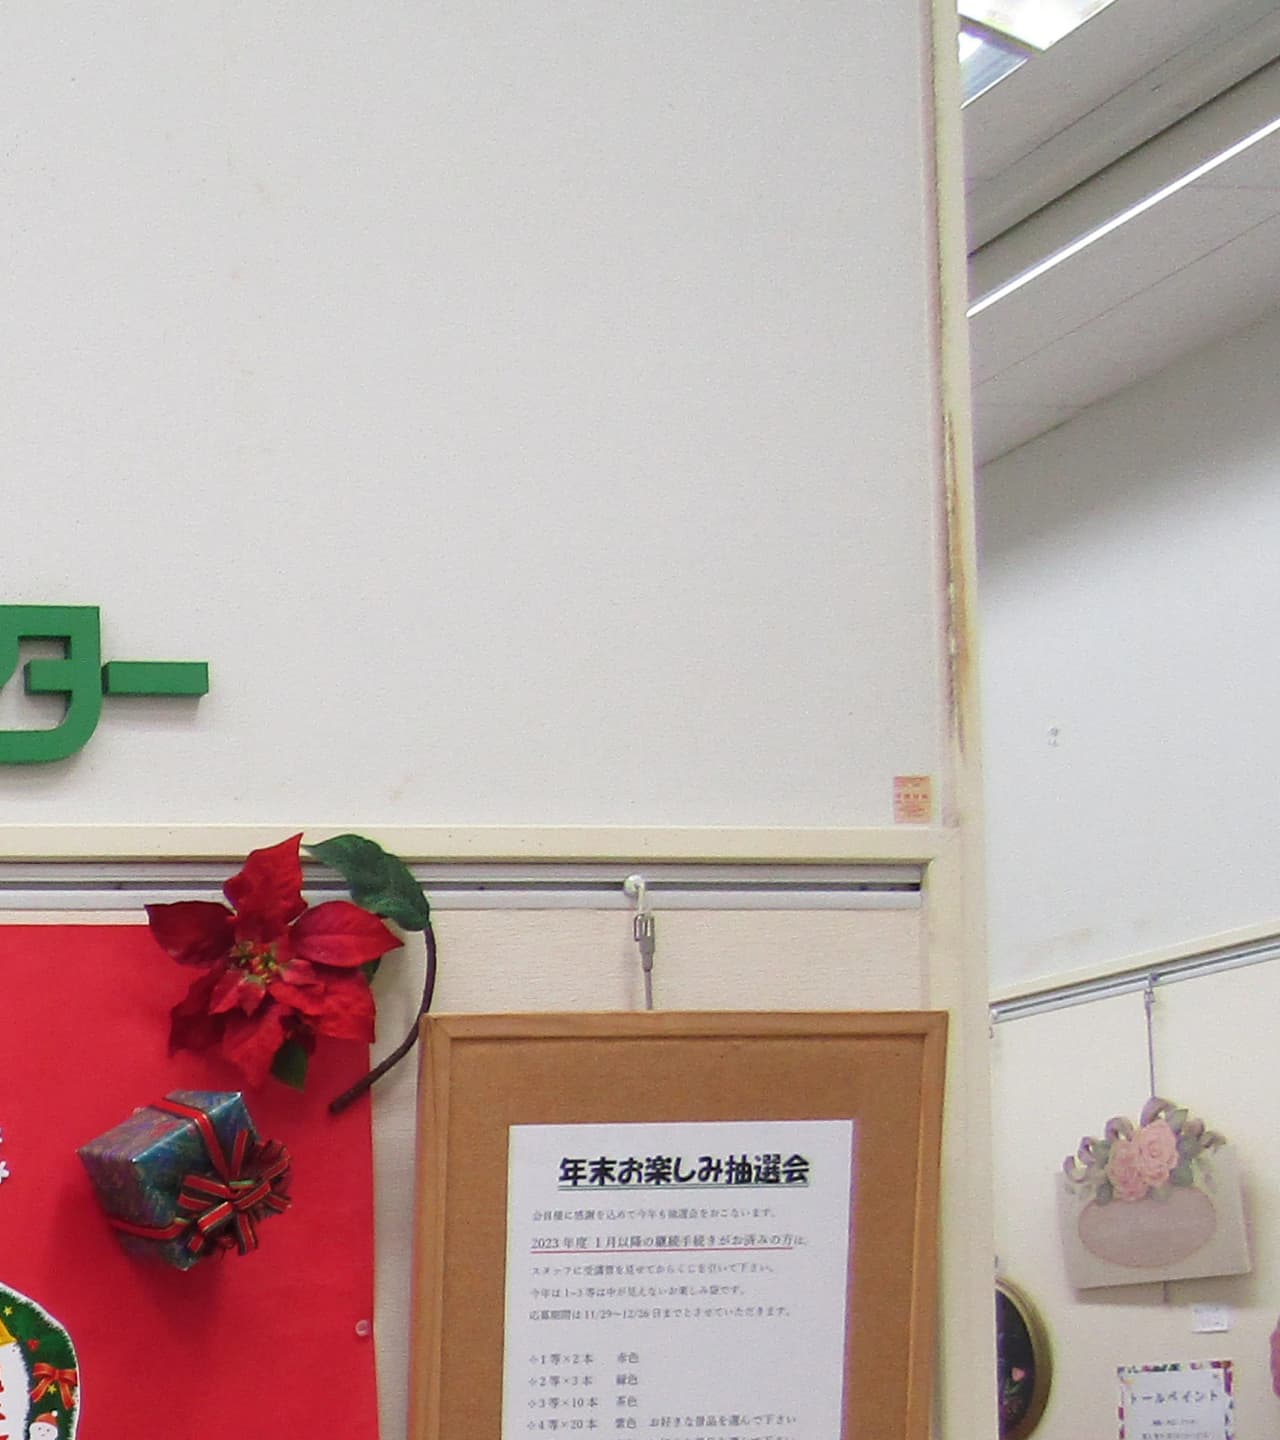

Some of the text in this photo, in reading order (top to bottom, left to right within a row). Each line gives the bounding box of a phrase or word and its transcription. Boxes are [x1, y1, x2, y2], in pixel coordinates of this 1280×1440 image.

[558, 1154, 810, 1185] 年末お楽しみ抽選会
